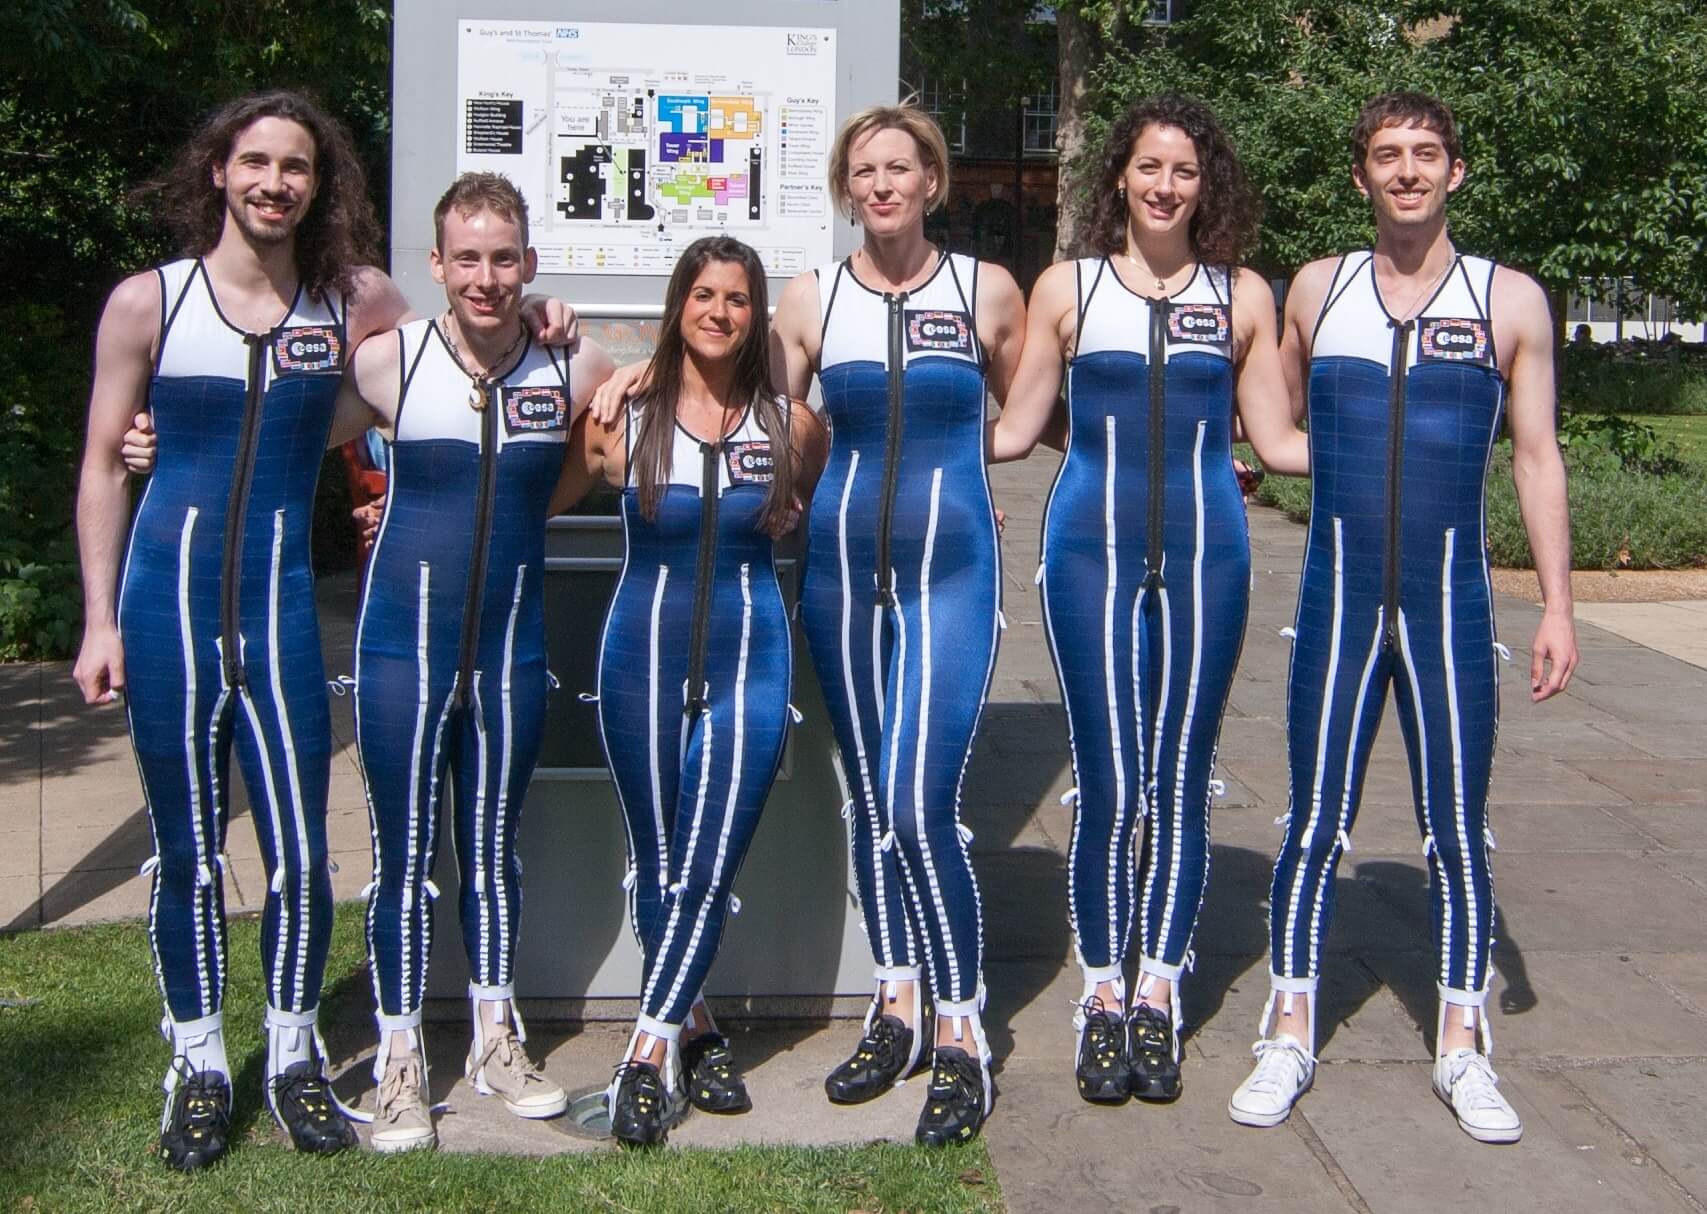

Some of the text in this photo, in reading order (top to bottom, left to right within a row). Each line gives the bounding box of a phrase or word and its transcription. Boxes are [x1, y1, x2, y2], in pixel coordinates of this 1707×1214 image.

[479, 29, 499, 38] Guy's
[501, 91, 514, 99] Key
[806, 97, 819, 105] Key
